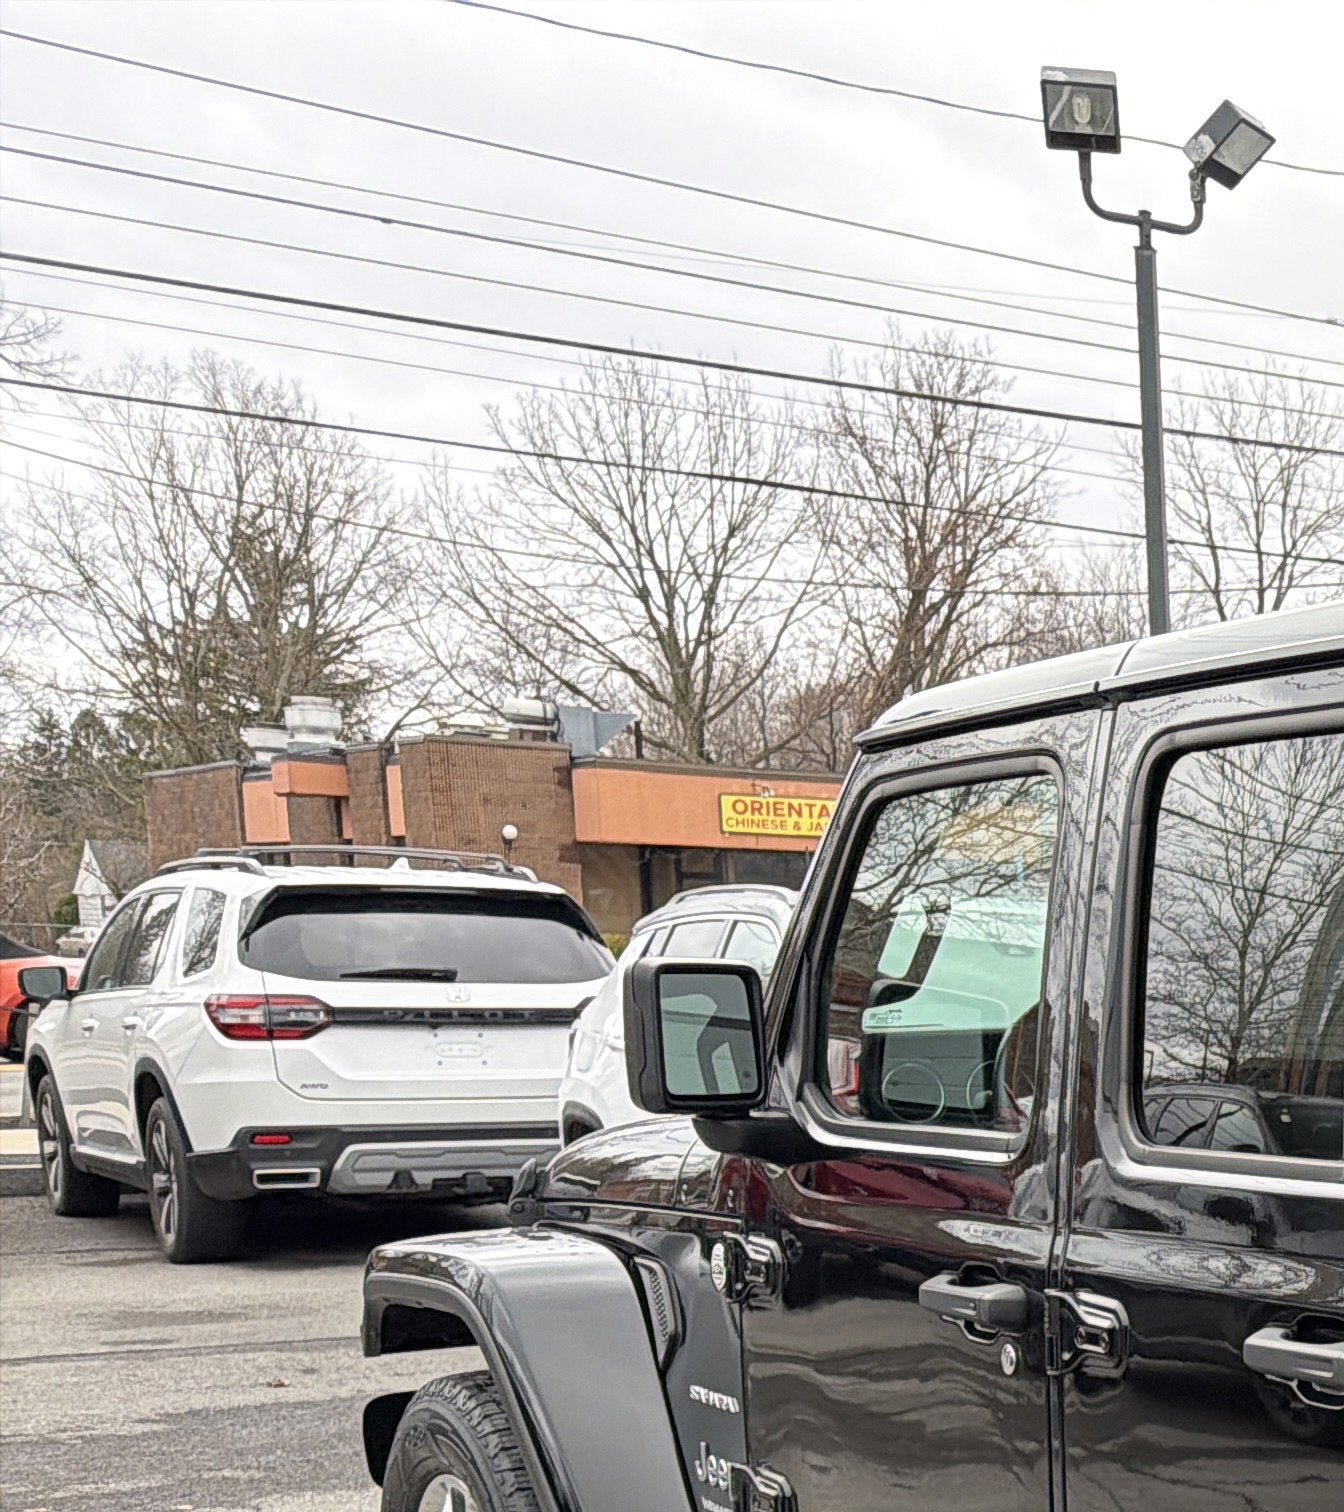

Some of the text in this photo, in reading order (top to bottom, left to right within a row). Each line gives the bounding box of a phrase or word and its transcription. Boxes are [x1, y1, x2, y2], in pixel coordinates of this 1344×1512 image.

[732, 798, 831, 819] ORIENTA
[725, 817, 827, 832] CHINESE & JA
[695, 1441, 731, 1491] Jee
